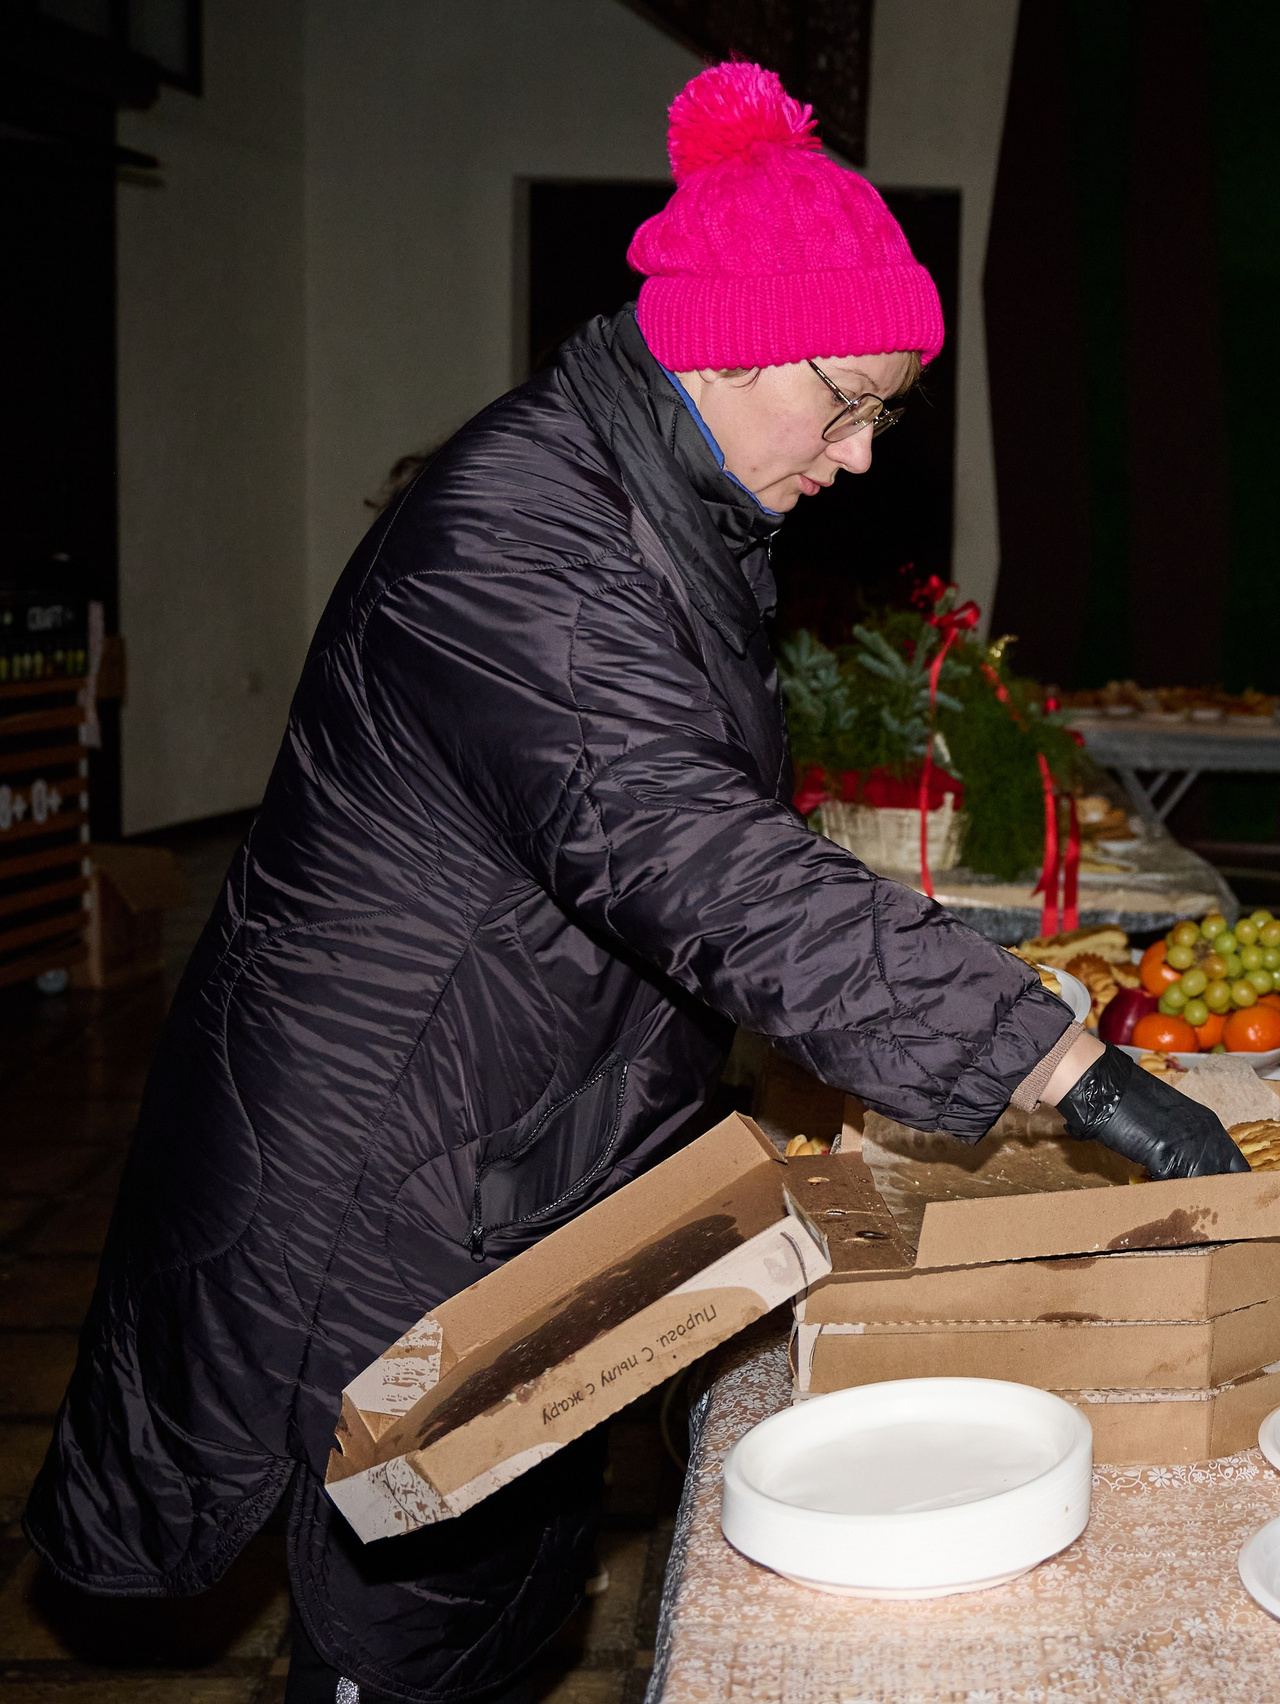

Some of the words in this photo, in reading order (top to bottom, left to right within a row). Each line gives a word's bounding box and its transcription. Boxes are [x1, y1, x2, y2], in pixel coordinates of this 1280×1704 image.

[656, 1304, 717, 1348] Пироги.
[641, 1346, 654, 1362] С
[601, 1355, 639, 1387] пылу
[586, 1383, 596, 1395] с
[542, 1391, 584, 1425] жару
